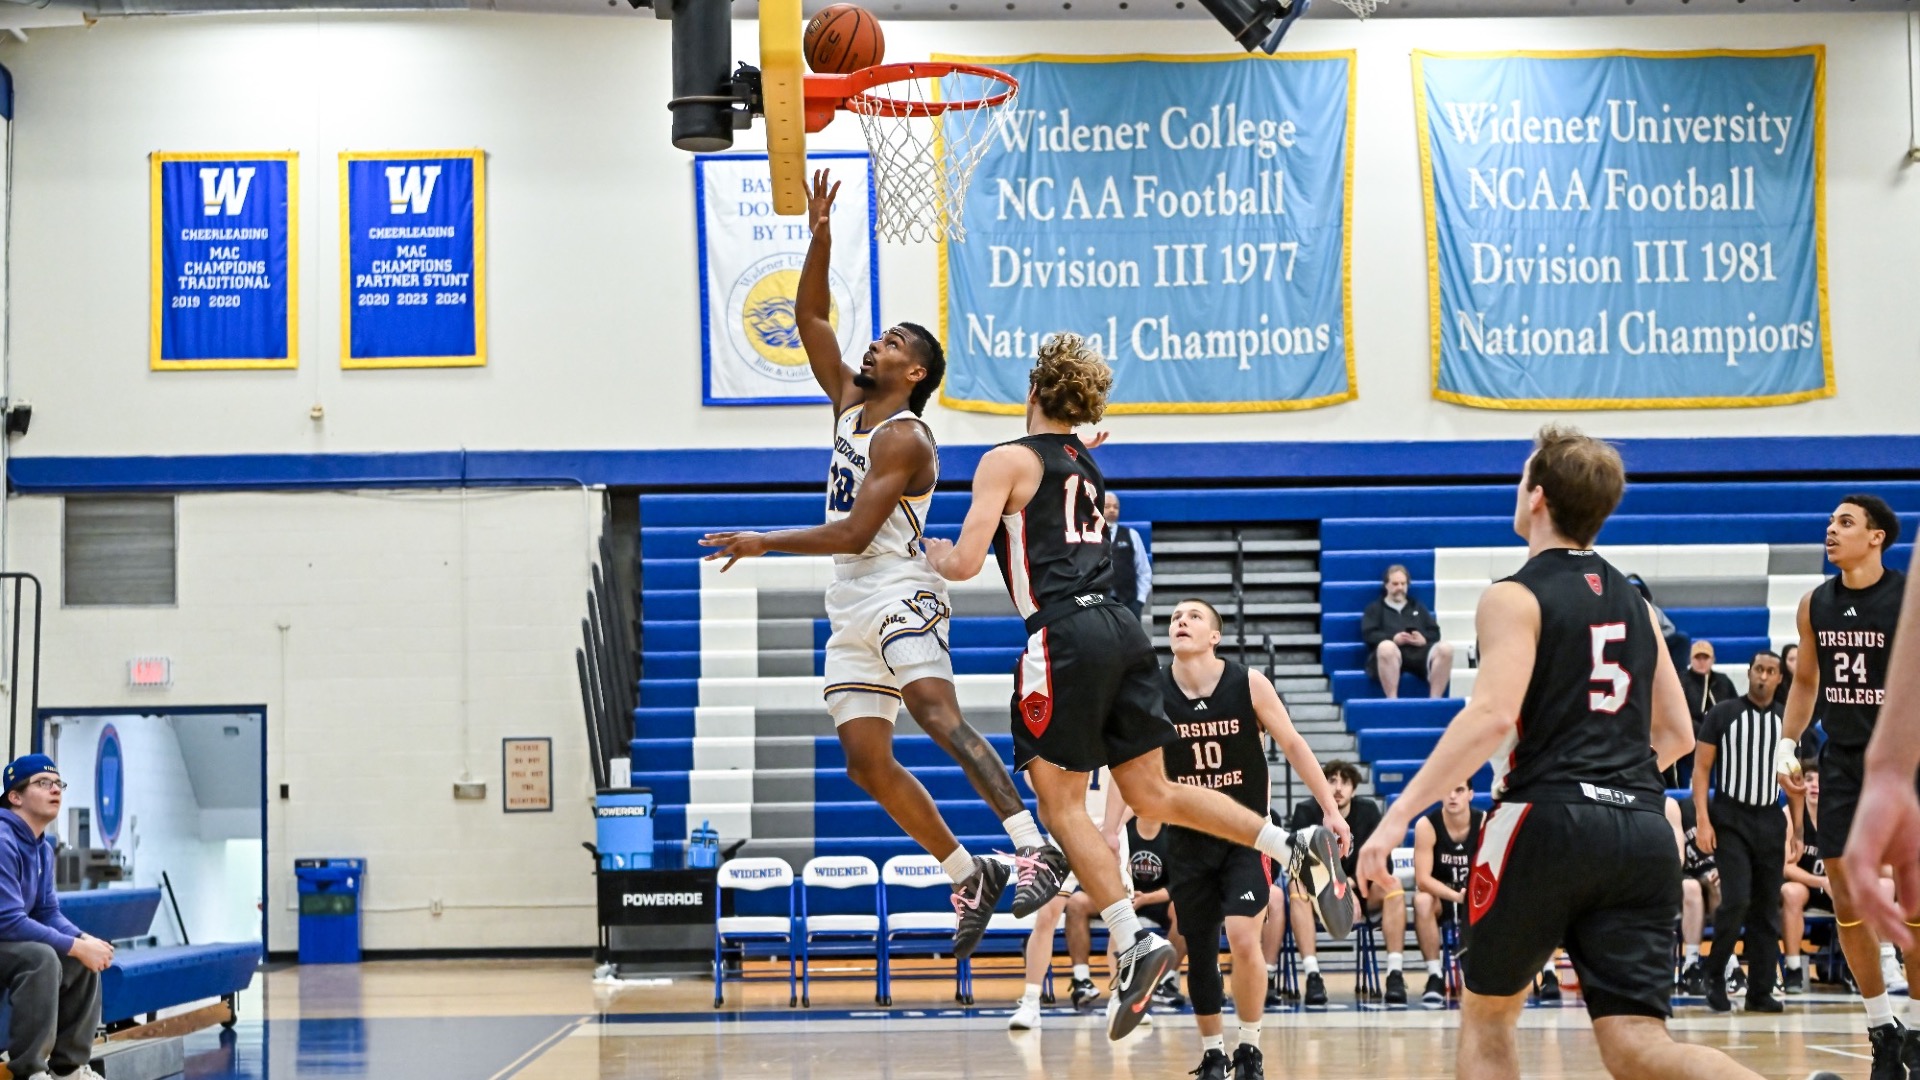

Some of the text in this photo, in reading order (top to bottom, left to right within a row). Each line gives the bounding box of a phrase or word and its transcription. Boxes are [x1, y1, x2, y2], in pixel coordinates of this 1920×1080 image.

[994, 103, 1296, 159] Widener College
[1444, 99, 1793, 155] Widener University
[199, 167, 256, 216] W
[385, 165, 442, 215] W
[996, 170, 1284, 222] NCAA Football
[1467, 166, 1755, 212] NCAA Football
[181, 228, 269, 241] CHEERLEADING
[368, 226, 455, 239] CHEERLEADING
[753, 224, 812, 241] BY TH
[209, 246, 240, 260] MAC
[396, 245, 427, 258] MAC
[184, 261, 266, 275] CHAMPIONS
[372, 259, 452, 274] CHAMPIONS
[989, 241, 1298, 288] Division III 1977
[1471, 240, 1778, 285] Division III 1981
[356, 273, 469, 288] PARTNER STUNT
[740, 259, 784, 287] Widener
[178, 275, 271, 290] TRADITIONAL
[172, 295, 241, 308] 2019 2020
[358, 293, 467, 306] 2020 2023 2024
[966, 313, 1330, 370] Natial Champions
[1457, 310, 1814, 366] National Champions
[754, 356, 773, 373] Blue
[1064, 474, 1105, 544] 13
[1818, 631, 1886, 648] URSINUS
[1589, 622, 1632, 715] 5
[1834, 652, 1867, 684] 24
[1825, 686, 1886, 705] COLLEGE
[1192, 741, 1223, 770] 10
[598, 806, 645, 816] POWERADE
[729, 867, 782, 880] WIDENER
[814, 866, 868, 877] WIDENER
[622, 892, 704, 907] POWERADE
